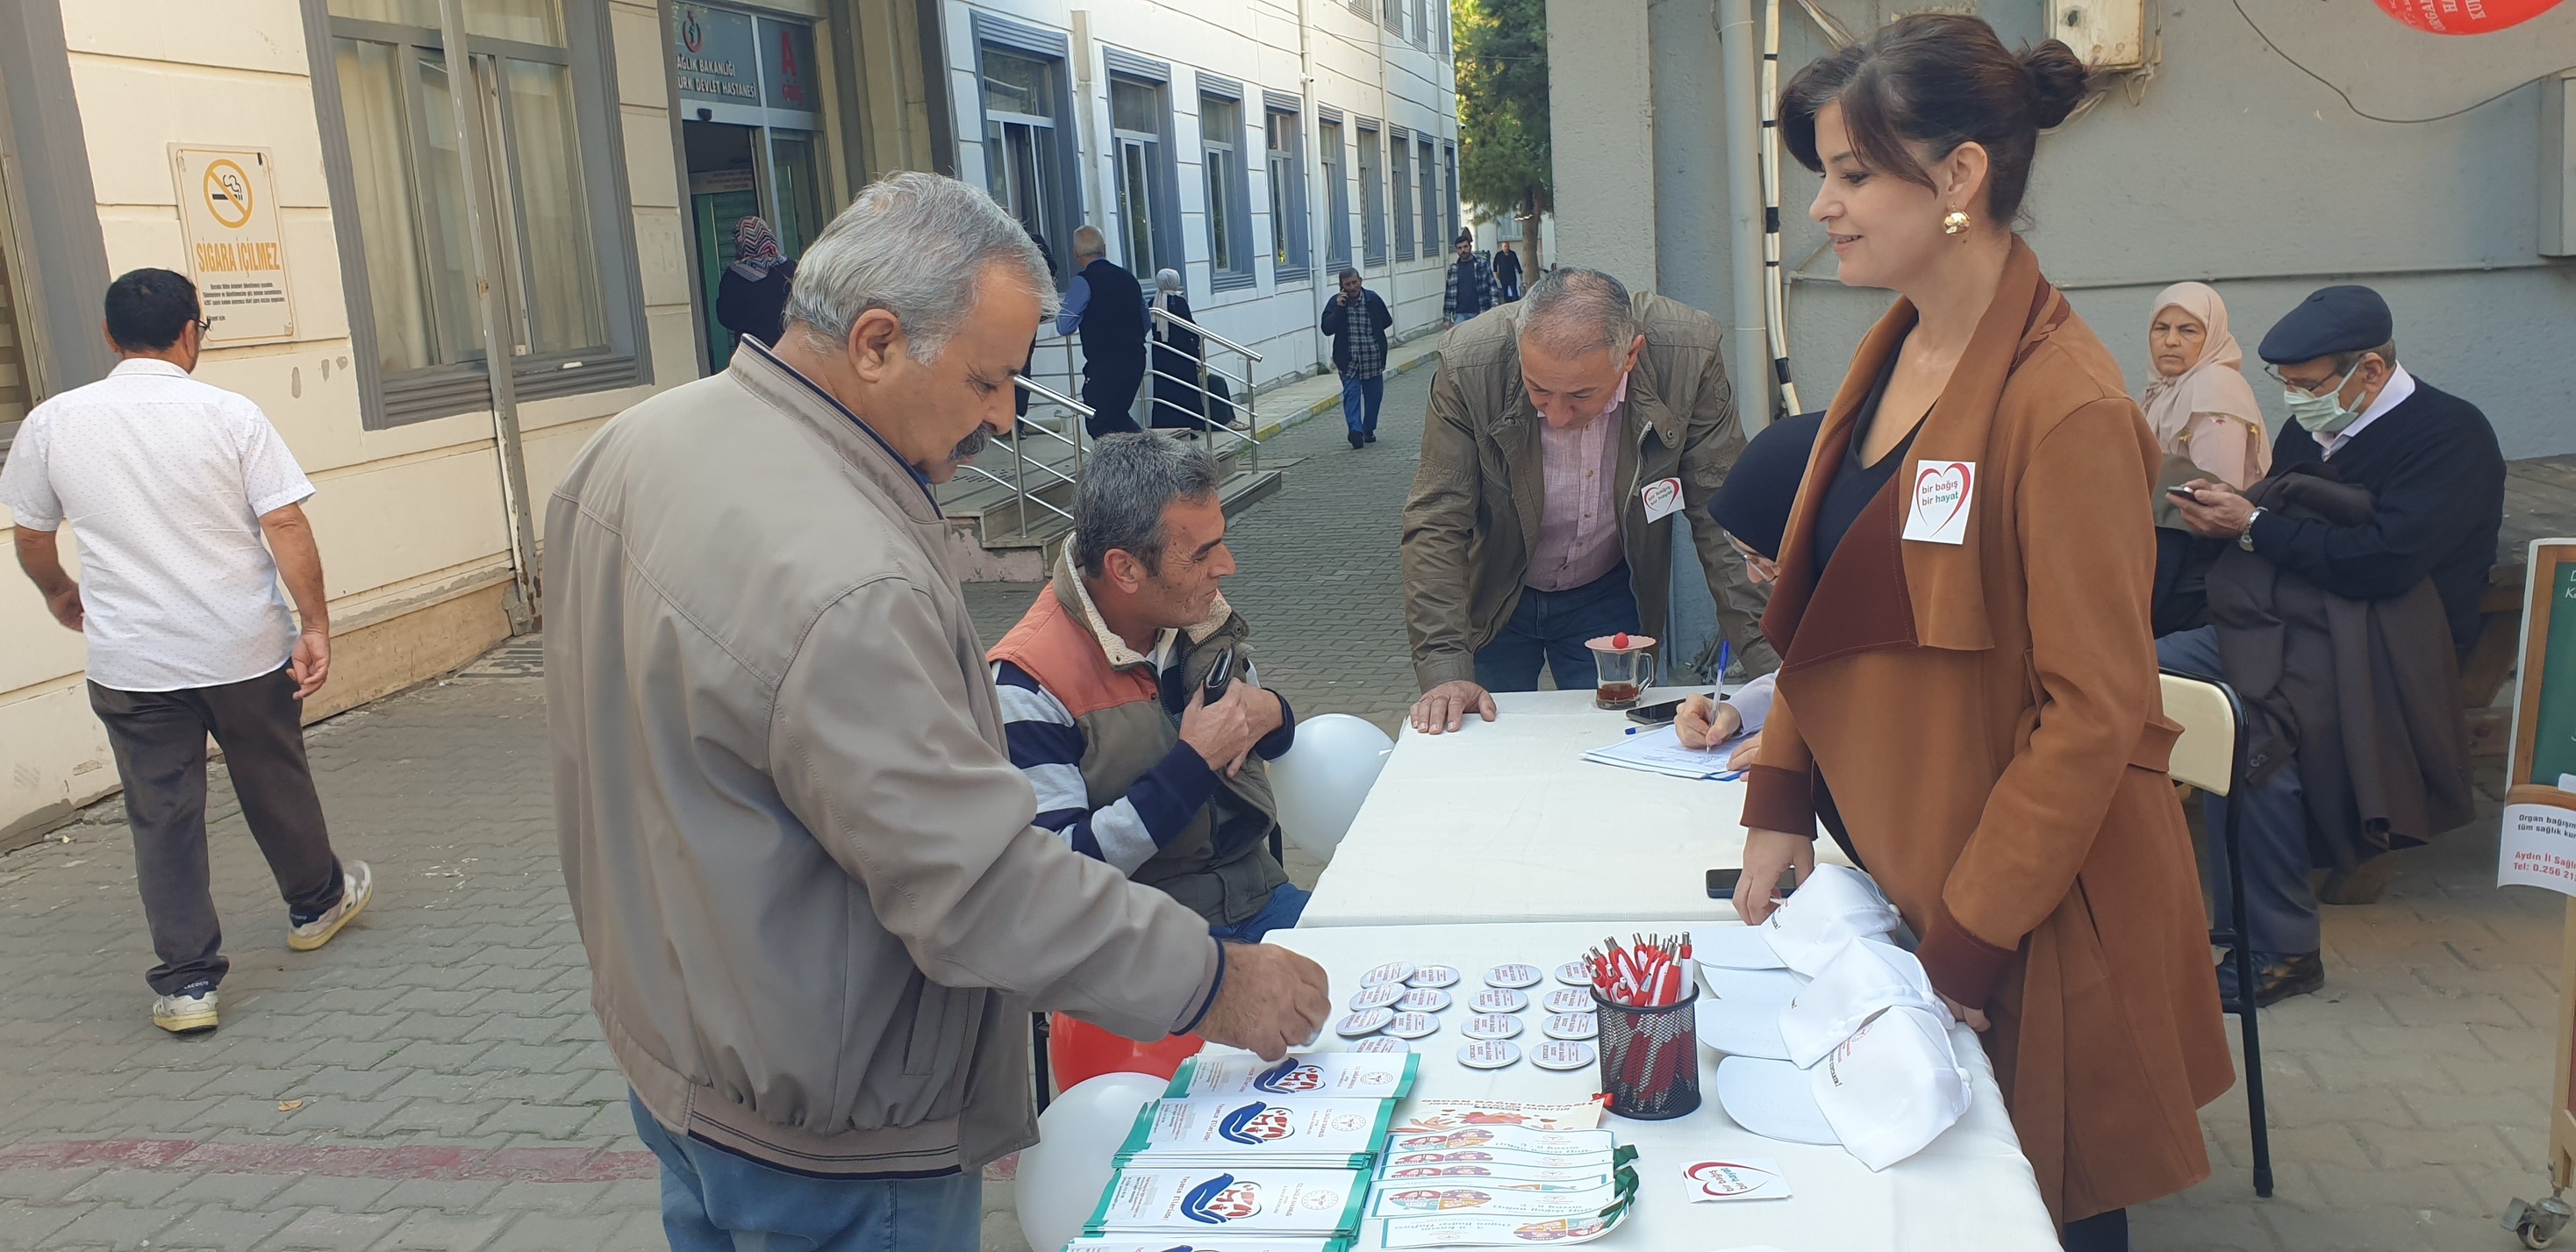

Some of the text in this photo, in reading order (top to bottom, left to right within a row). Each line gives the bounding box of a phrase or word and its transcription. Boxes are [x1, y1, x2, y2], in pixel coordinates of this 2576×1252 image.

[676, 54, 735, 77] AĞLIK BAKANLIĞI
[696, 78, 720, 94] DEVLET
[722, 82, 756, 98] HASTANESİ
[197, 237, 281, 277] SİGARA İÇİLMEZ
[1922, 481, 1958, 494] bir bağış
[1922, 491, 1958, 506] bir hayat
[2536, 826, 2561, 834] sağlık
[2515, 851, 2541, 860] Aydın
[2533, 864, 2560, 876] 0.256
[1709, 1170, 1727, 1184] bağış
[1720, 1168, 1739, 1182] hayat
